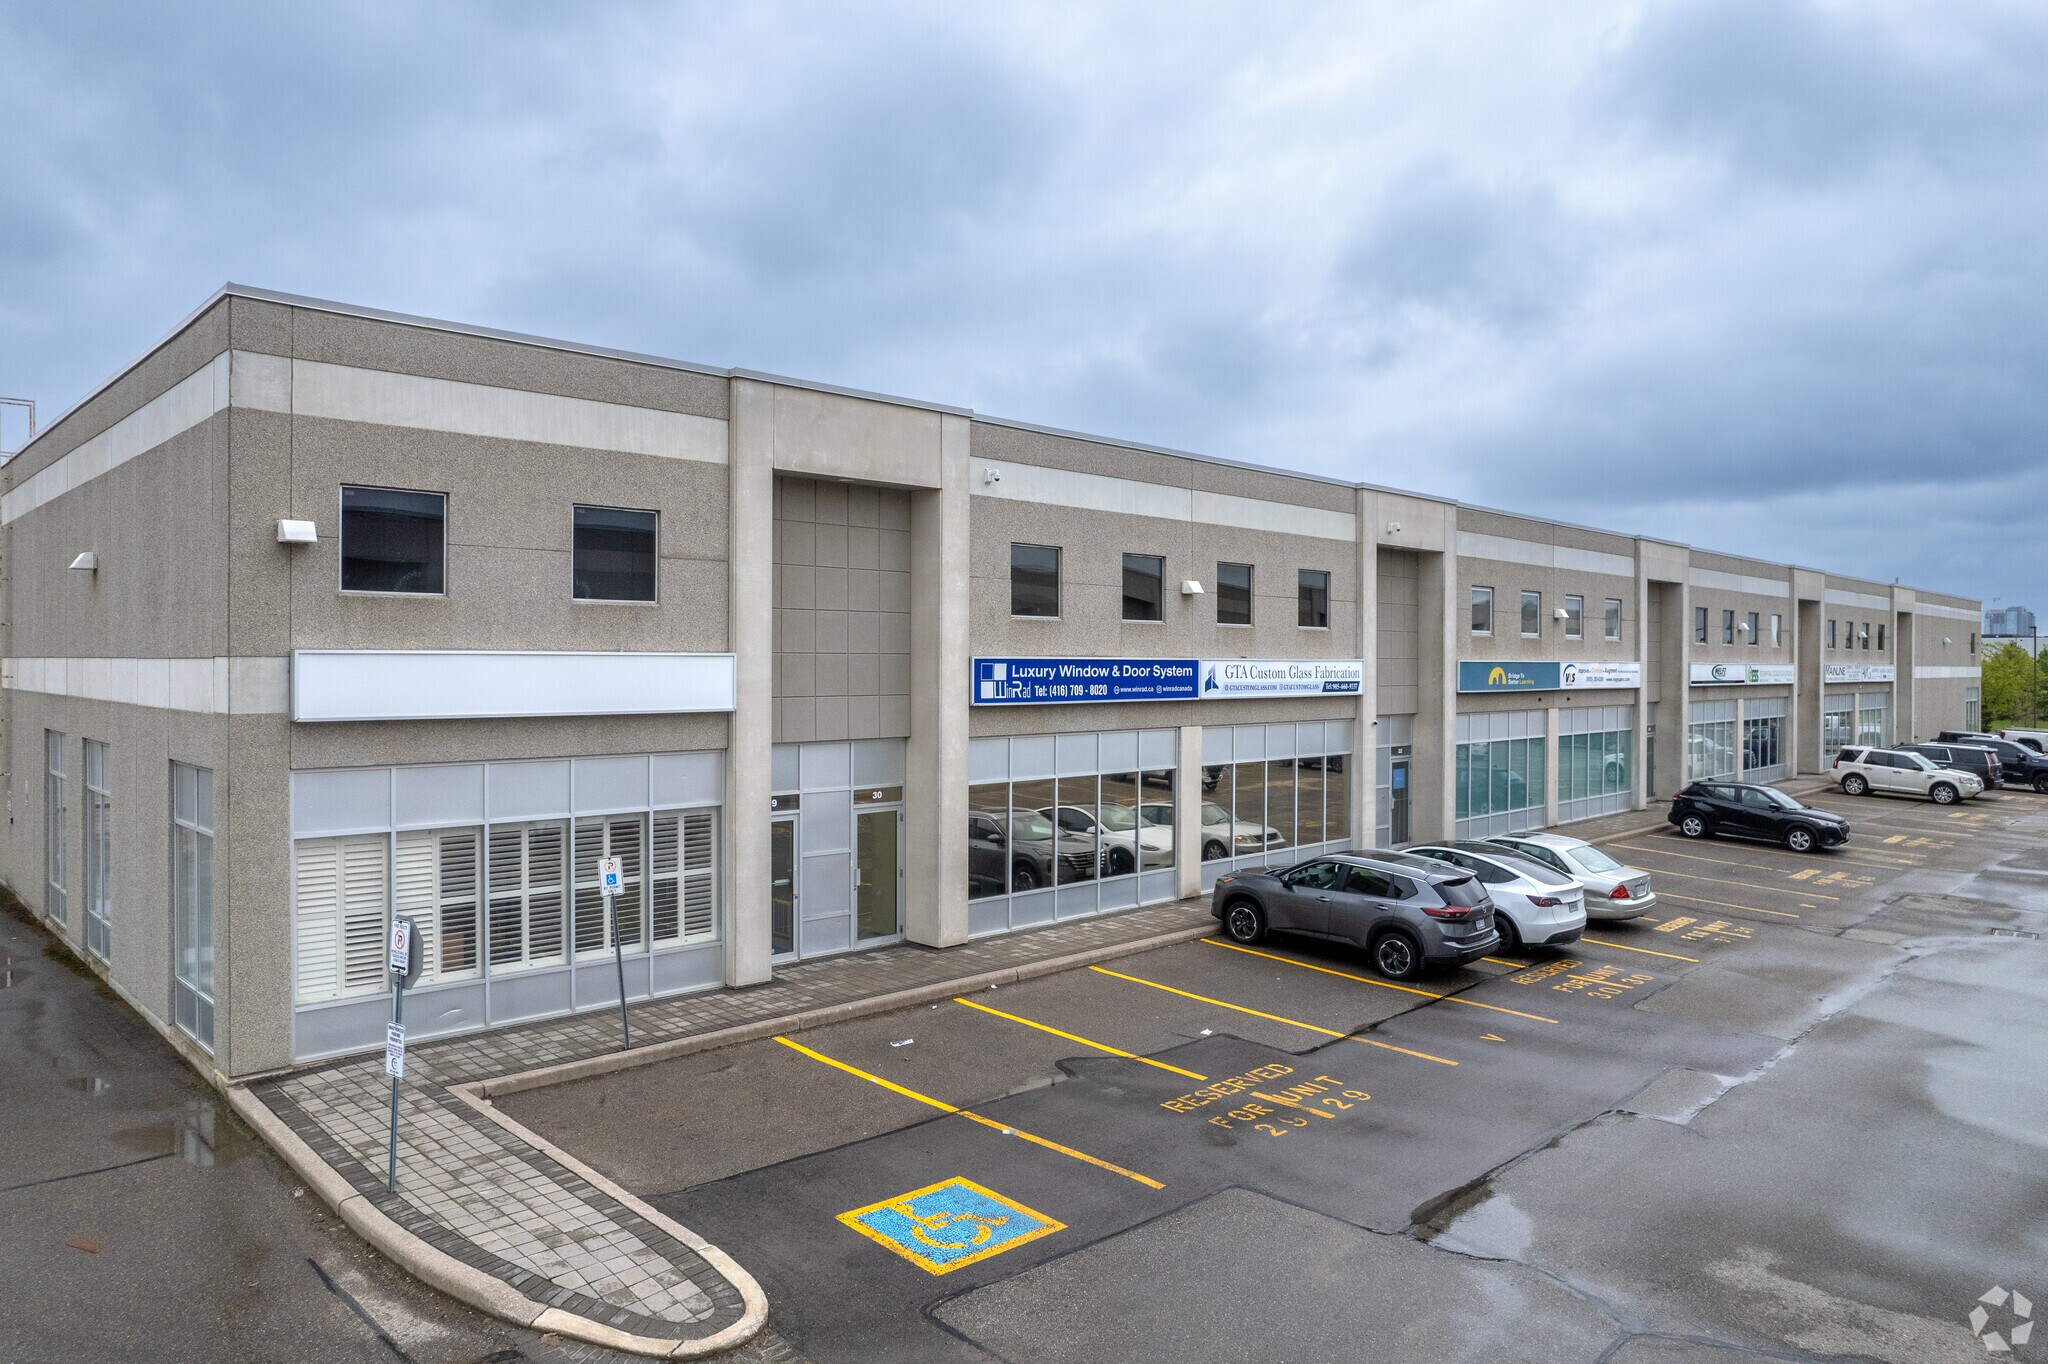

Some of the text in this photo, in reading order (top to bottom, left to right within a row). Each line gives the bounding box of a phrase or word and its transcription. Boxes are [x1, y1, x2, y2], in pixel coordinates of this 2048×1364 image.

[1012, 665, 1192, 680] Luxury Window & Door System
[1225, 664, 1360, 679] GTA Custom Glass Fabrication
[994, 681, 1031, 699] WinRad
[1034, 684, 1048, 697] Tel:
[1049, 684, 1068, 697] (416)
[1070, 684, 1084, 696] 709
[1090, 684, 1108, 696] 8020
[872, 791, 882, 799] 30
[1508, 959, 1583, 985] RESERVED
[1552, 965, 1626, 993] FOR UNIT
[1587, 973, 1655, 999] 30 30
[1160, 1063, 1294, 1114] RESERVED
[1208, 1075, 1343, 1129] FOR UNIT
[1322, 1090, 1372, 1110] 29
